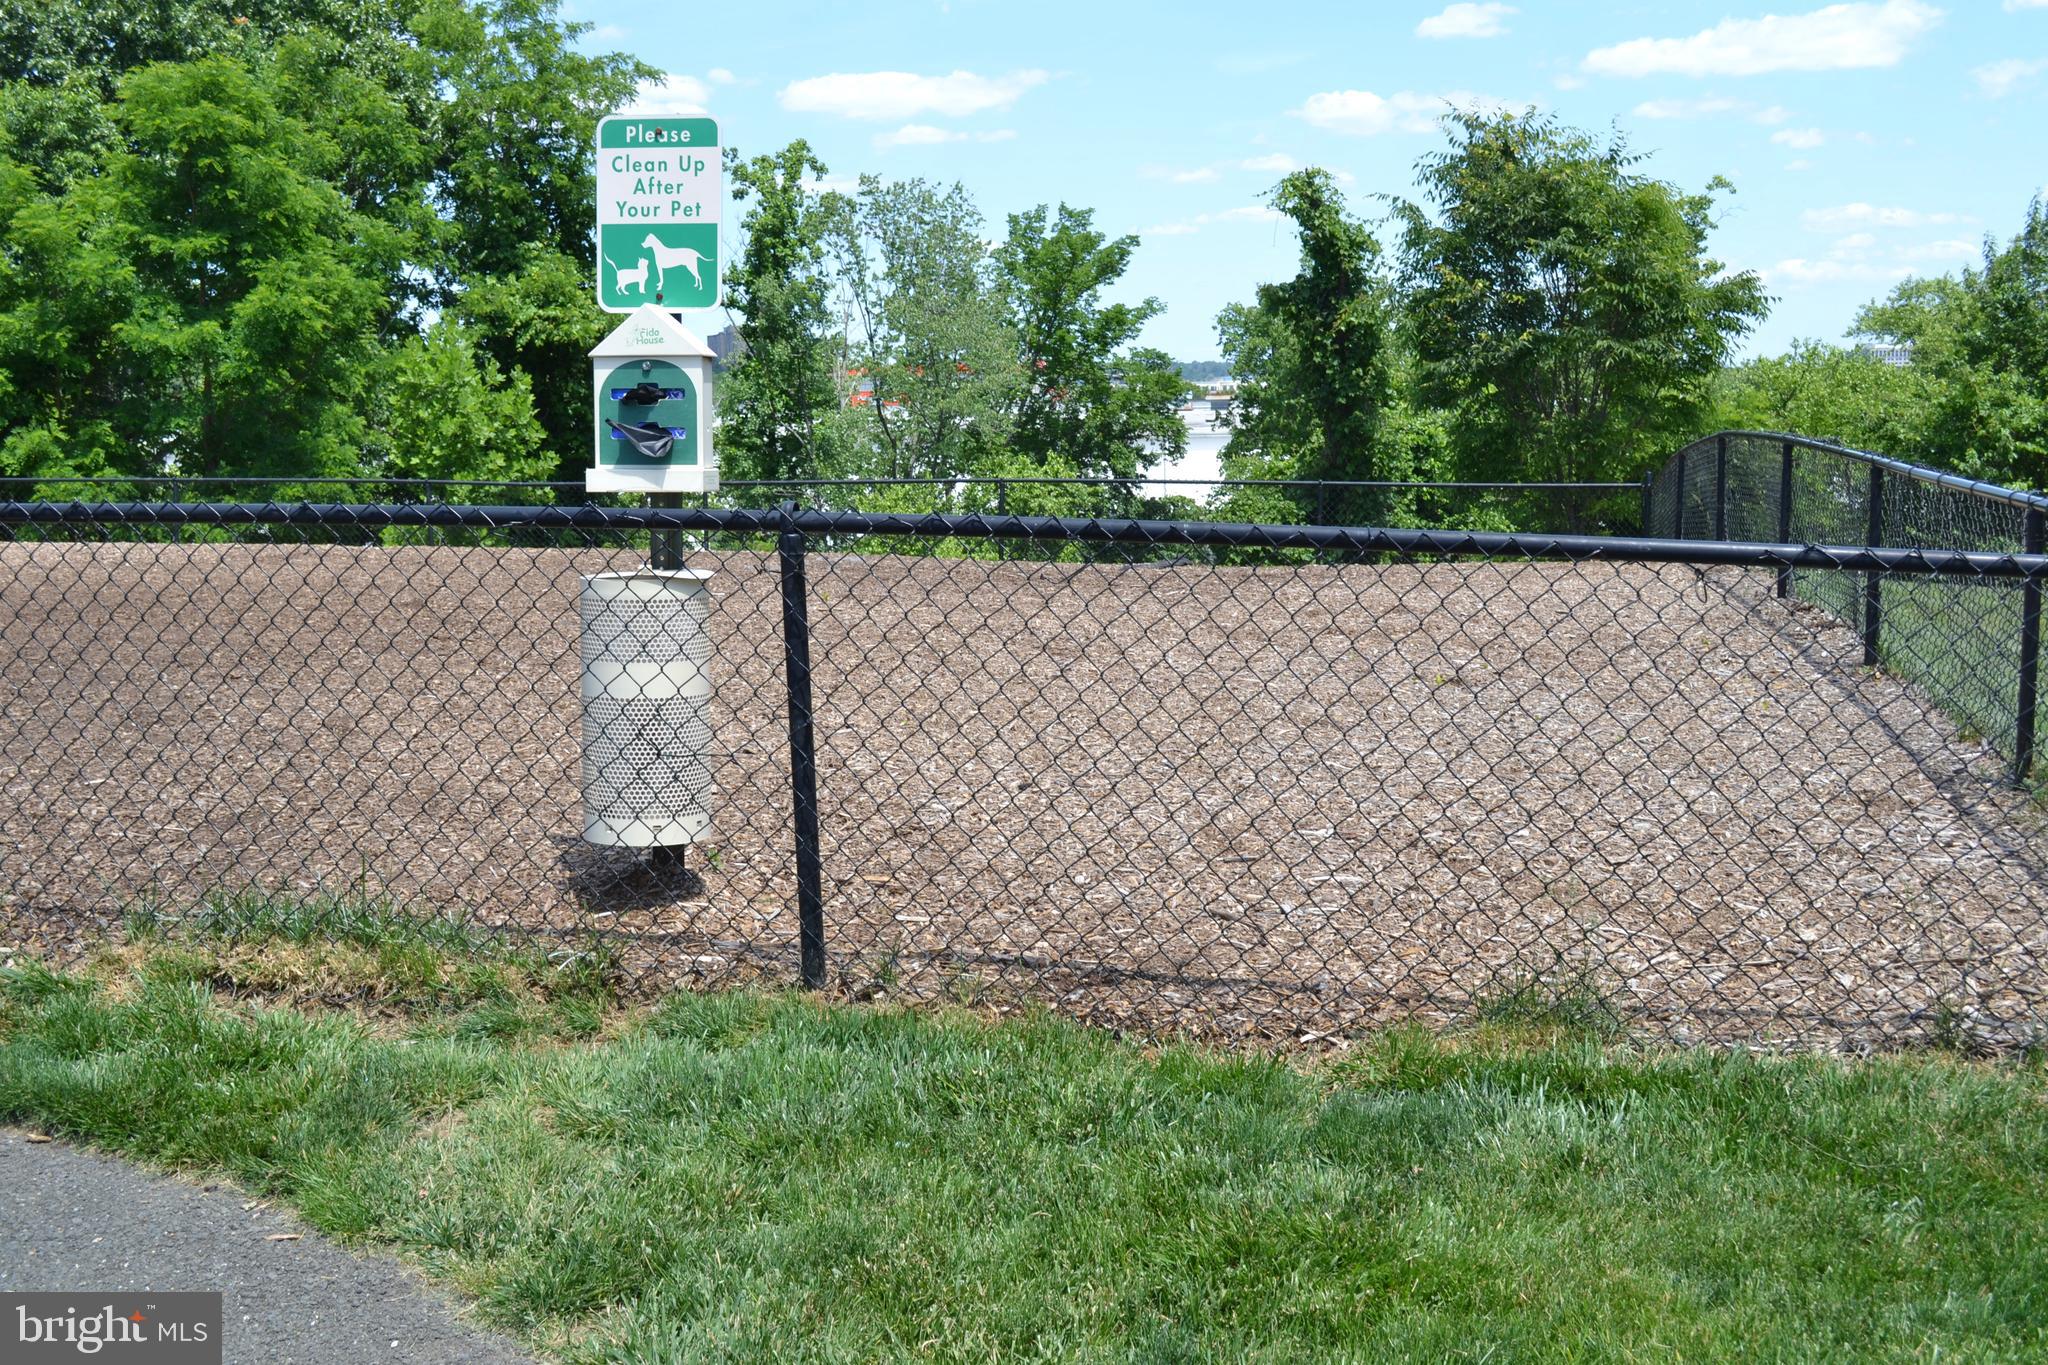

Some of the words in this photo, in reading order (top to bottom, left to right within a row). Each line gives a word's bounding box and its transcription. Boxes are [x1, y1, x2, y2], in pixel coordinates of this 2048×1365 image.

[626, 124, 691, 143] Please
[612, 154, 668, 173] Clean
[680, 155, 705, 177] Up
[633, 176, 684, 195] After
[616, 201, 661, 218] Your
[671, 201, 702, 217] Pet
[640, 328, 659, 338] Fido
